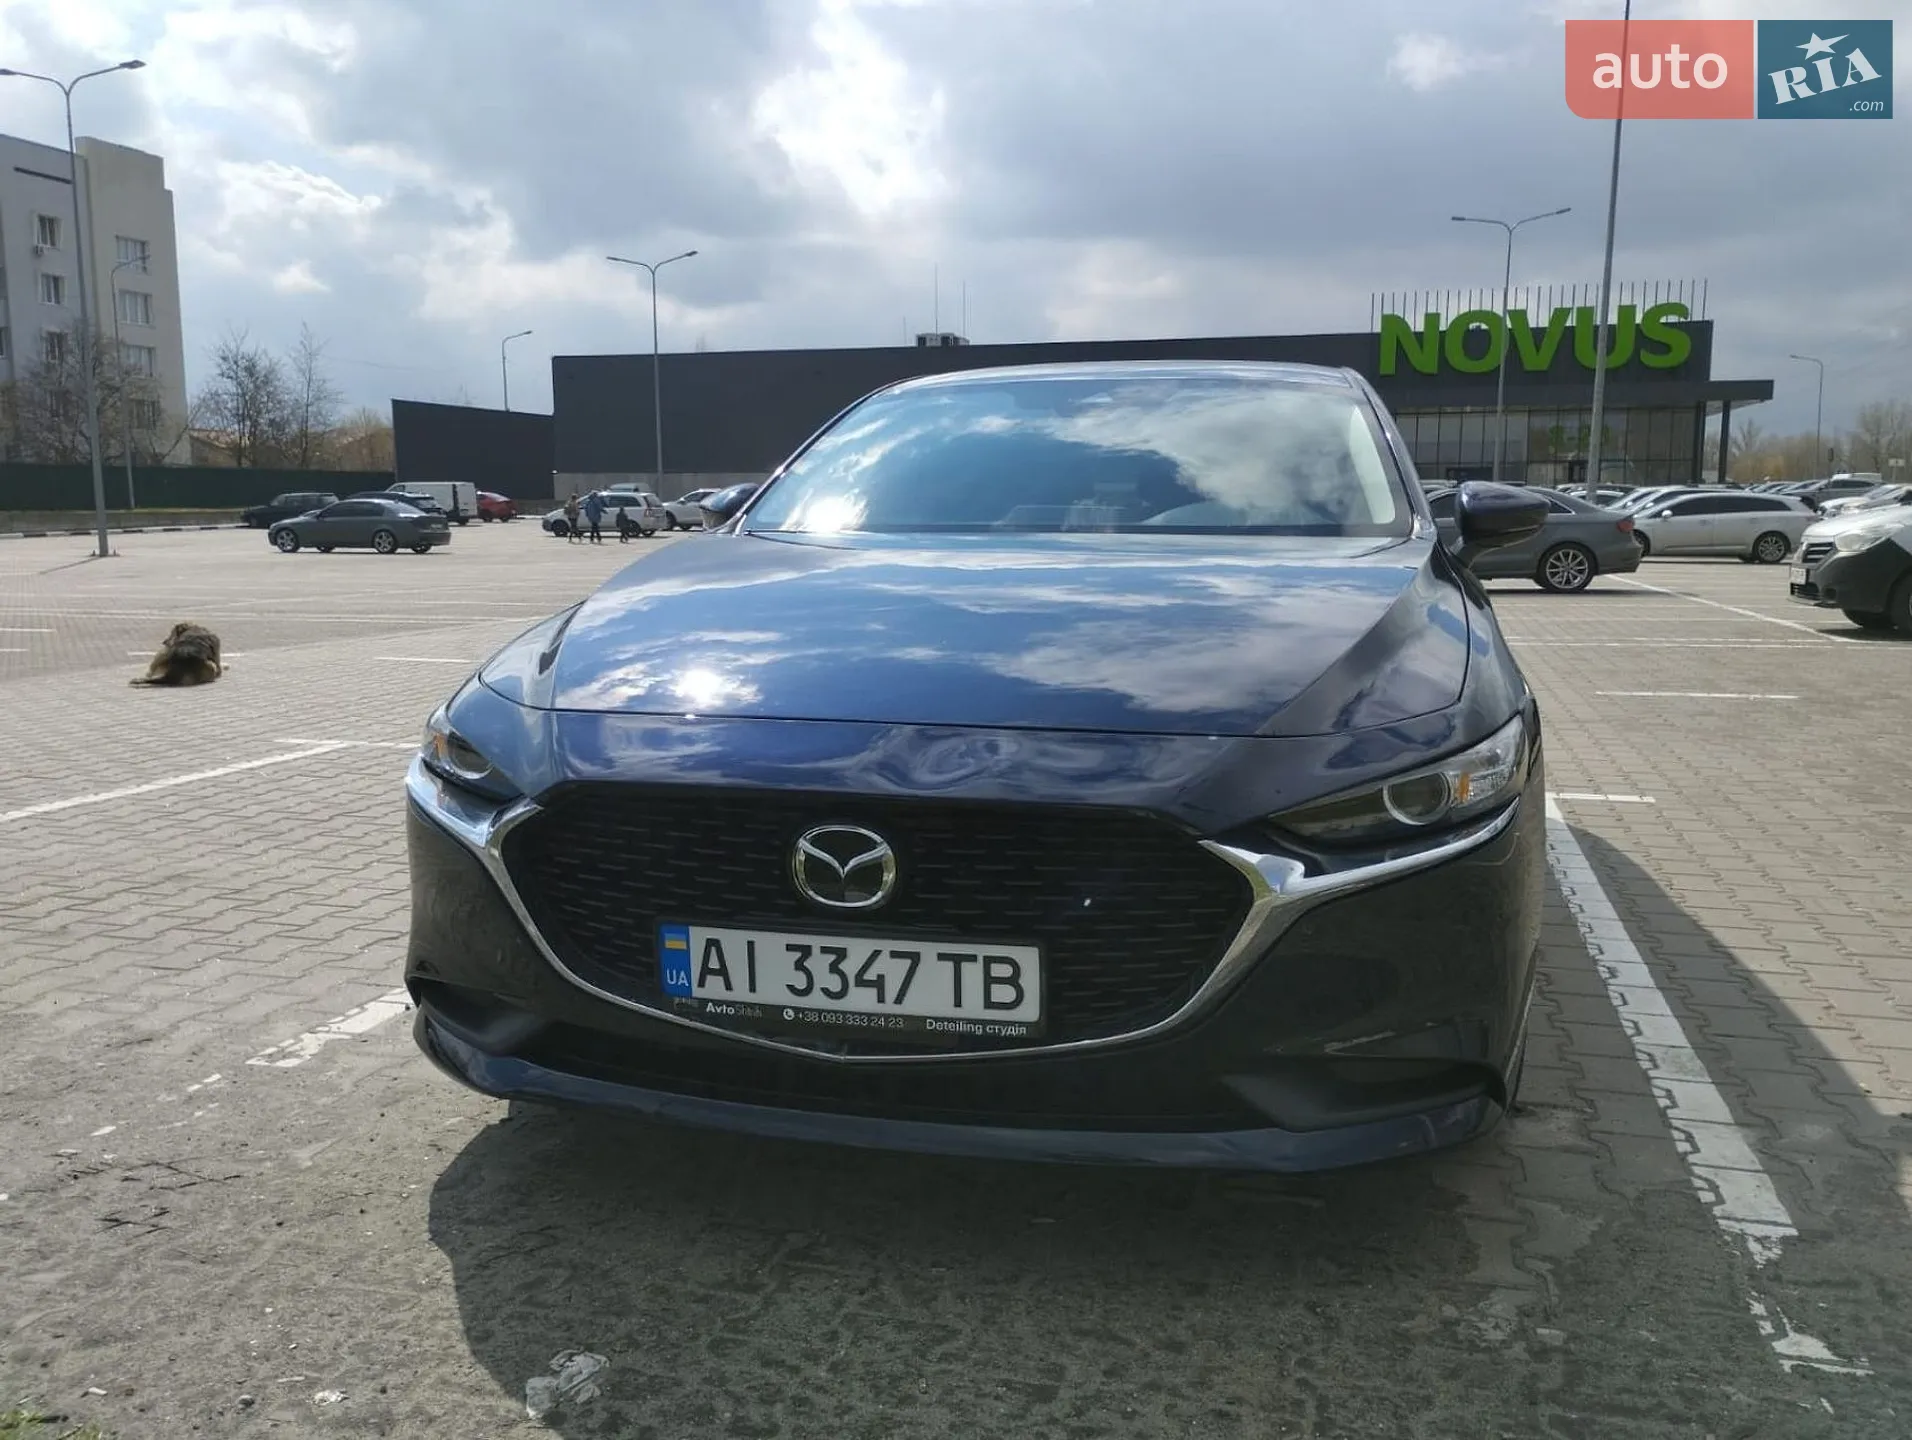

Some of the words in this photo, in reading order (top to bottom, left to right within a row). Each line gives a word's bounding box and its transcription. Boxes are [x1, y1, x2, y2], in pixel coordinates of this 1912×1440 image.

[1379, 302, 1693, 376] NOVUS
[666, 969, 689, 987] UA
[697, 937, 757, 994] AI
[785, 943, 921, 1005] 3347
[937, 951, 1025, 1011] TB
[821, 1012, 844, 1024] 093
[845, 1014, 869, 1026] 333
[986, 1023, 1027, 1037] студія
